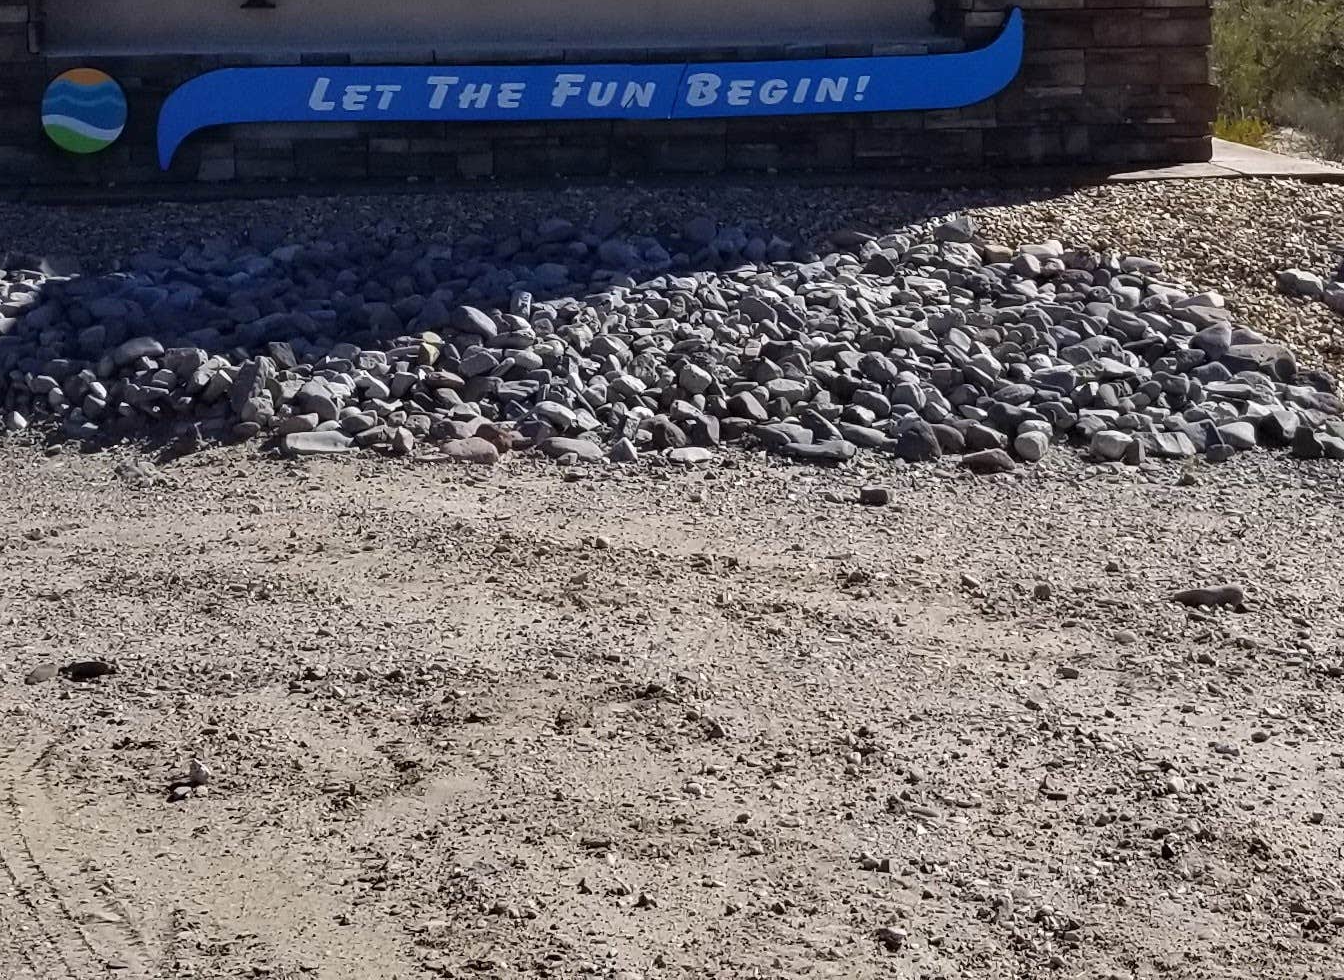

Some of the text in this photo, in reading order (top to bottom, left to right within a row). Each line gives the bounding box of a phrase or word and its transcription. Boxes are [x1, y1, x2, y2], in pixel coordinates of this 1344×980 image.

[308, 72, 871, 111] LET THE FUN BEGIN!
